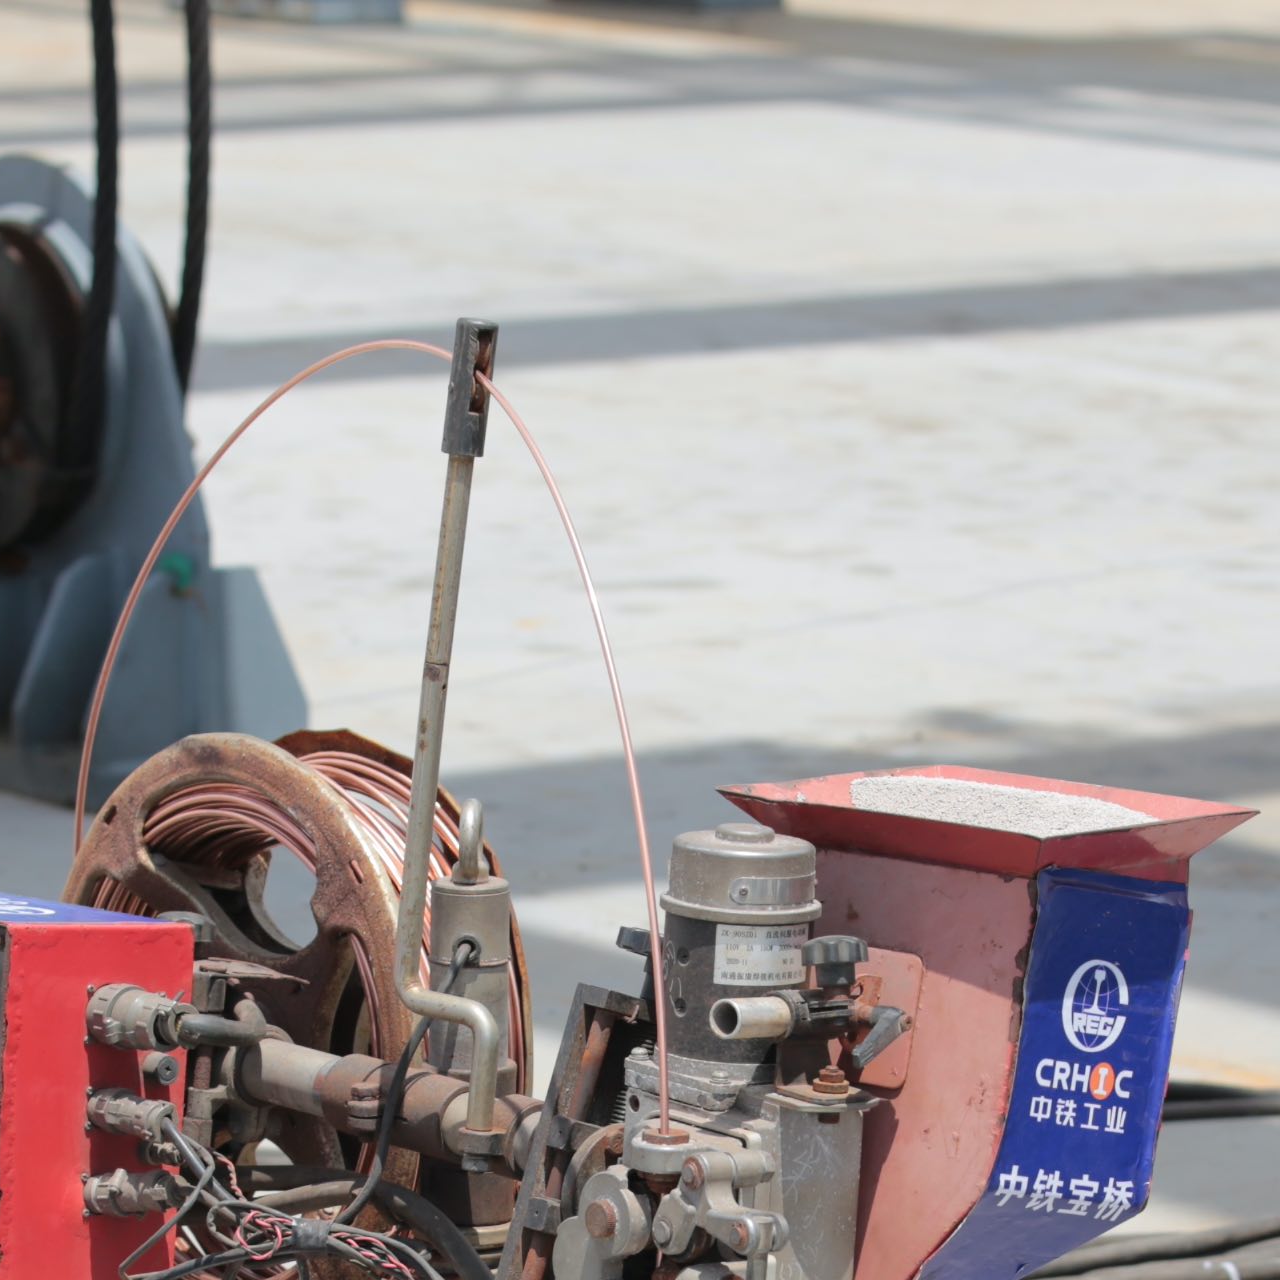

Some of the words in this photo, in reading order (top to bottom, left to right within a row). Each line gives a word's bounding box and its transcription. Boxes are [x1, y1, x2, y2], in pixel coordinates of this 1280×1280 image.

[1029, 1095, 1127, 1134] 中铁工业
[995, 1165, 1135, 1222] 中铁宝桥
